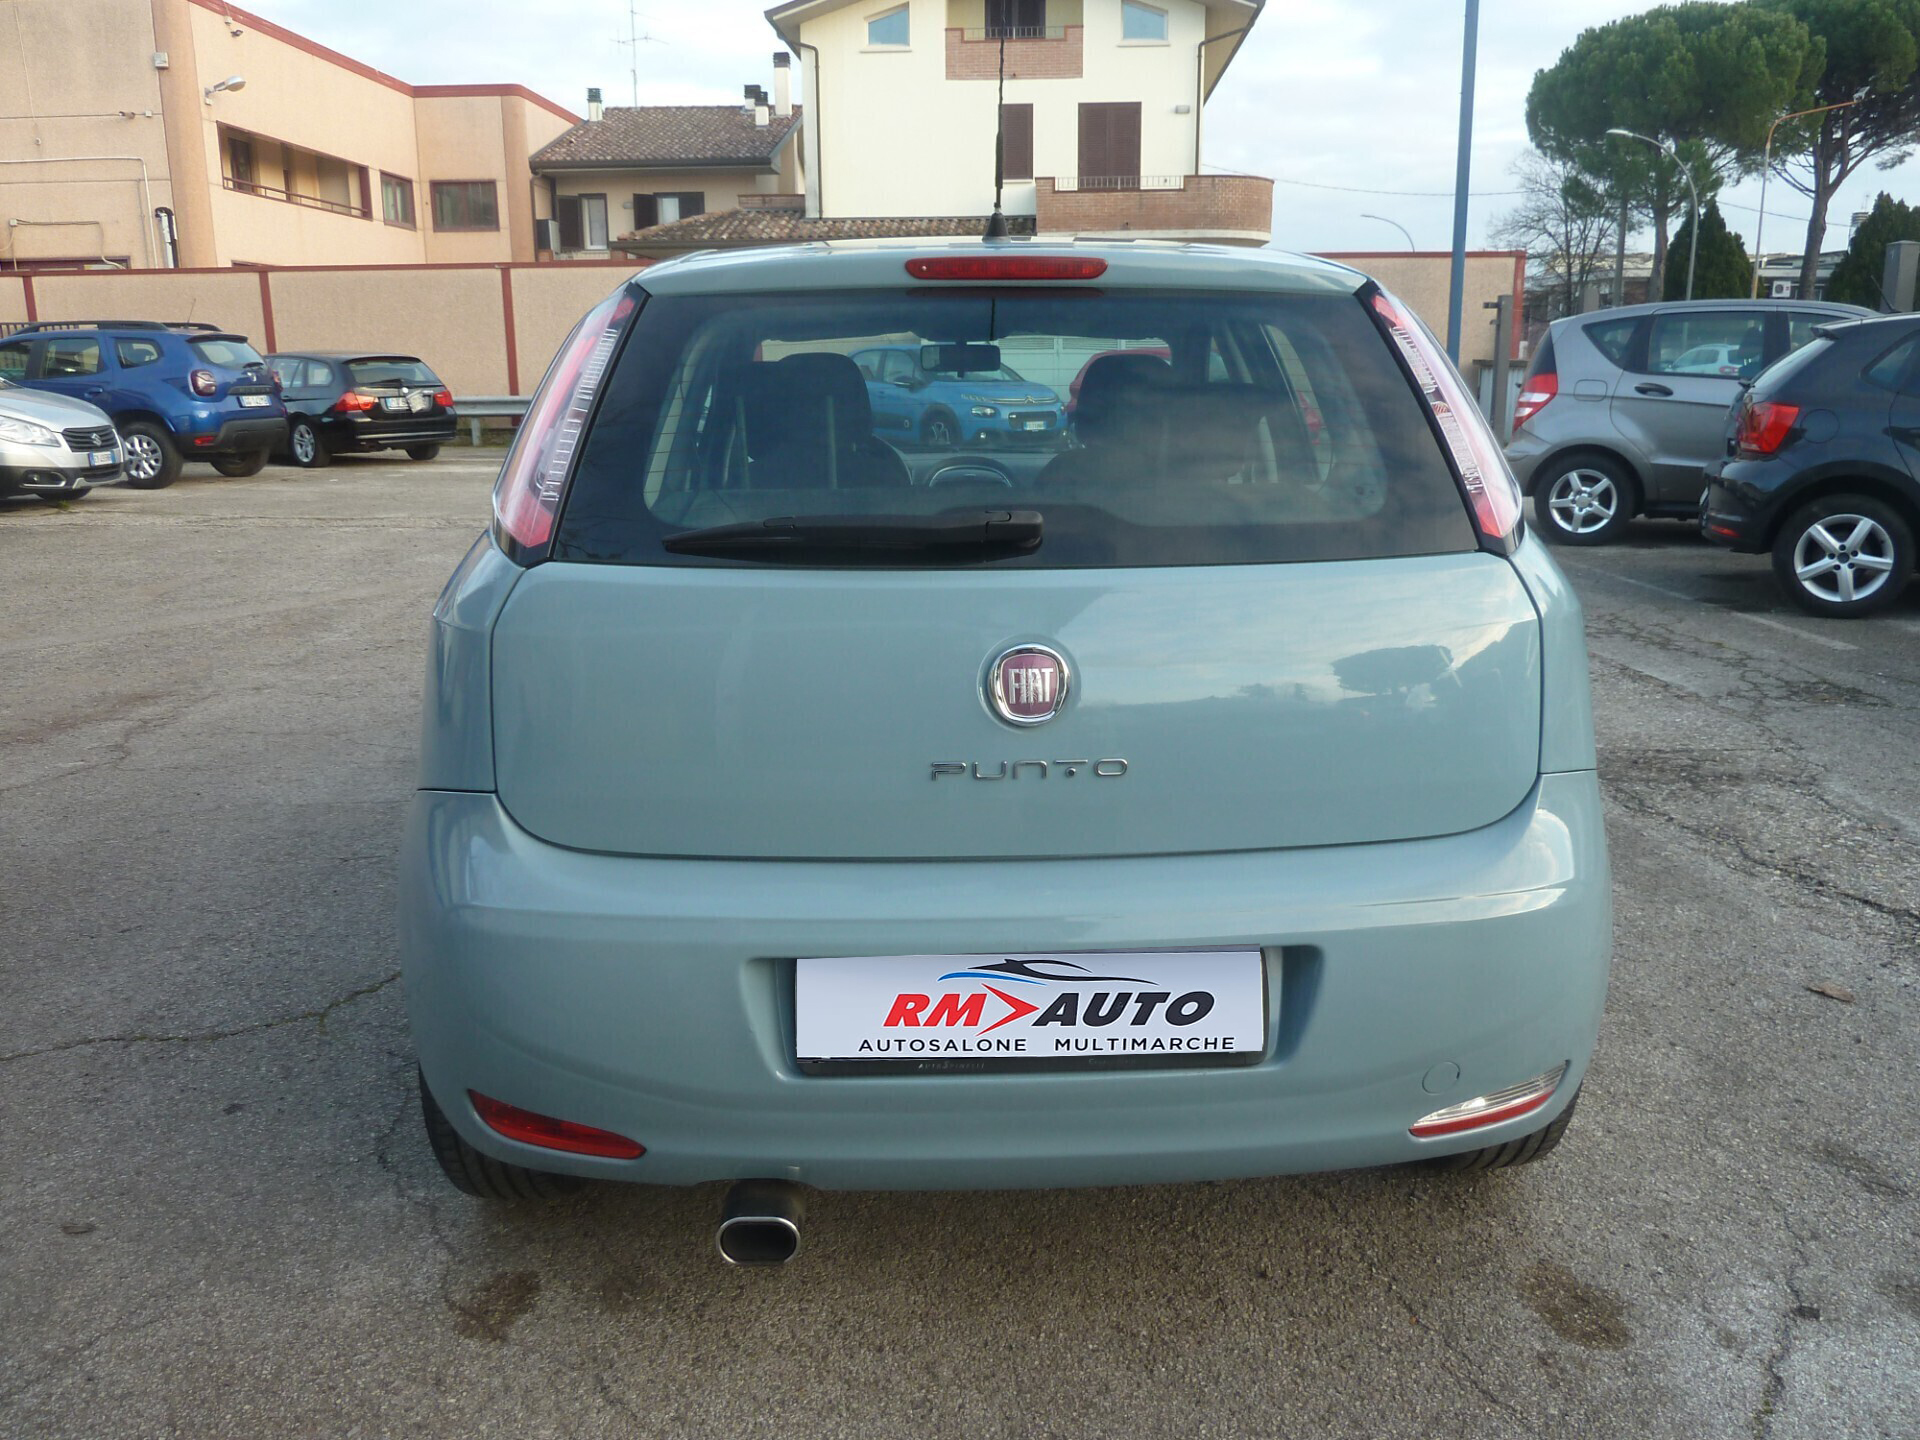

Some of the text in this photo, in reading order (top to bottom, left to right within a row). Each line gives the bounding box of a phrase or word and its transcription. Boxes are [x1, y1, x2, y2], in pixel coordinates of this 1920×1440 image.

[1008, 667, 1054, 705] FIAT
[931, 758, 1129, 781] PUNTO
[883, 990, 1216, 1027] RM AUTO
[858, 1036, 1236, 1053] AUTOSALONE MULTIMARCHE
